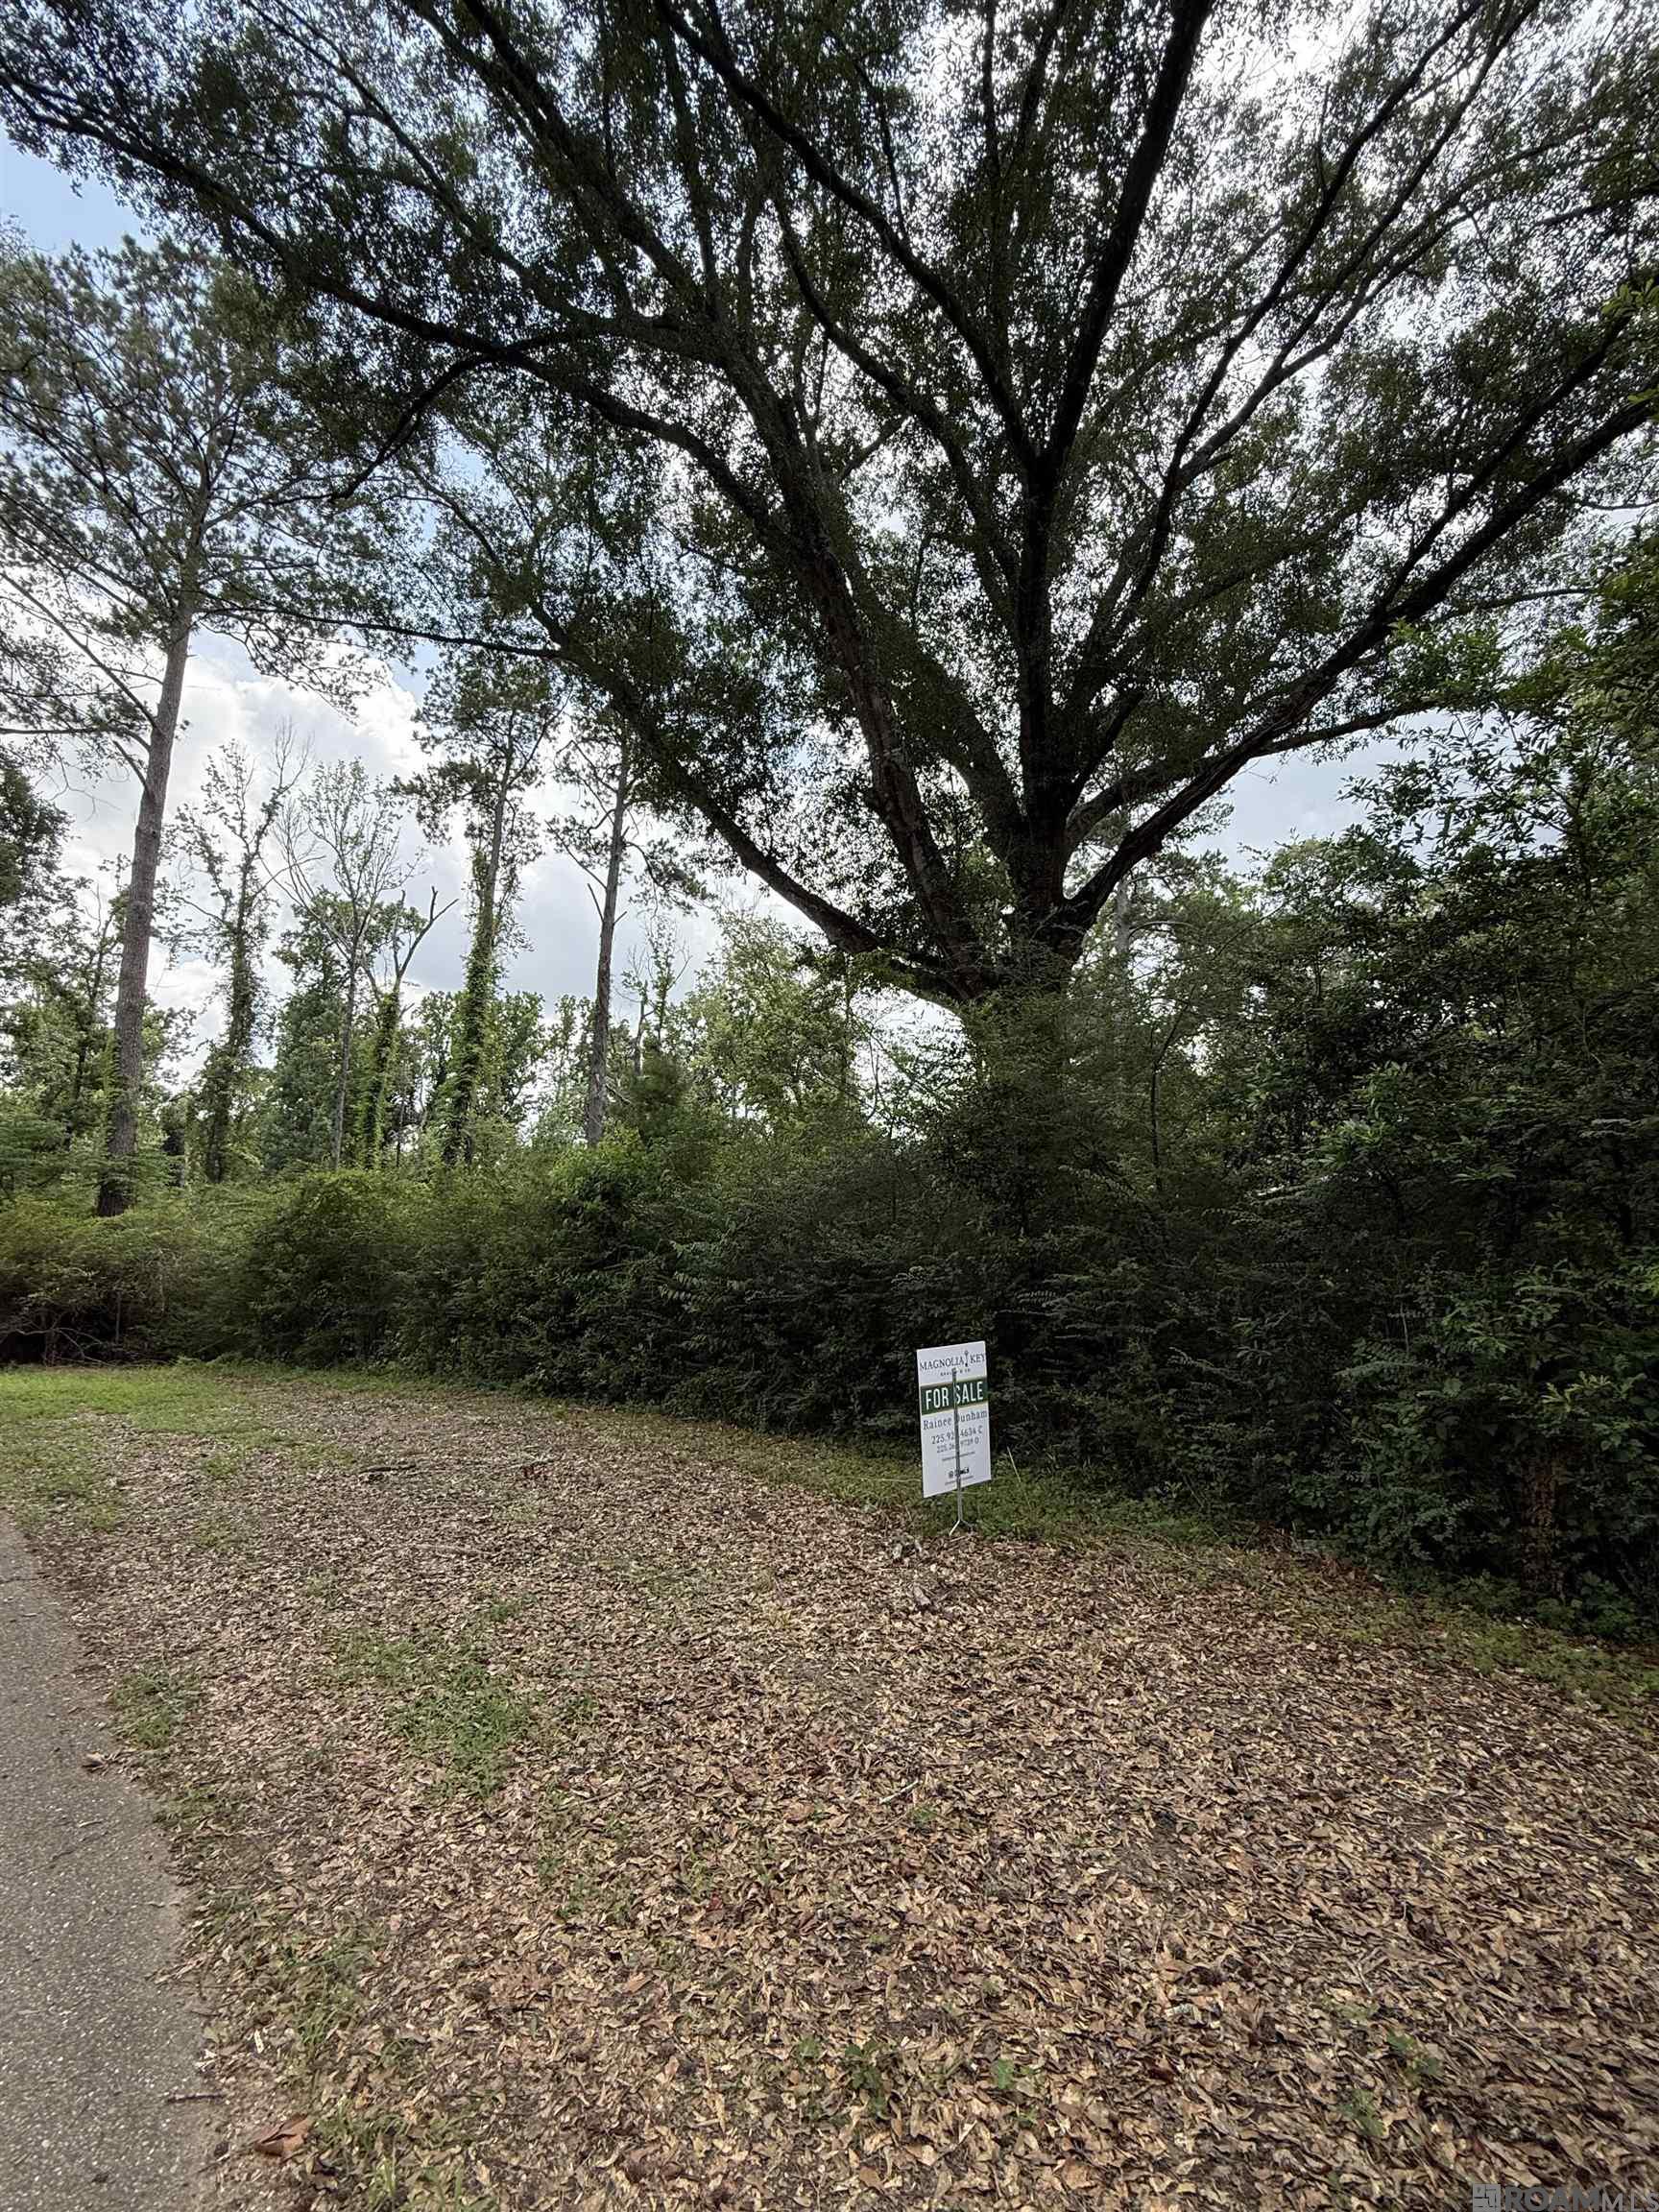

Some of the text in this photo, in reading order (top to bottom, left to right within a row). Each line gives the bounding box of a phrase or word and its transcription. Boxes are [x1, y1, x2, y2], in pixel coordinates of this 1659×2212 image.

[919, 1356, 964, 1371] MAGNOLIA
[926, 1381, 984, 1410] FOR SALE
